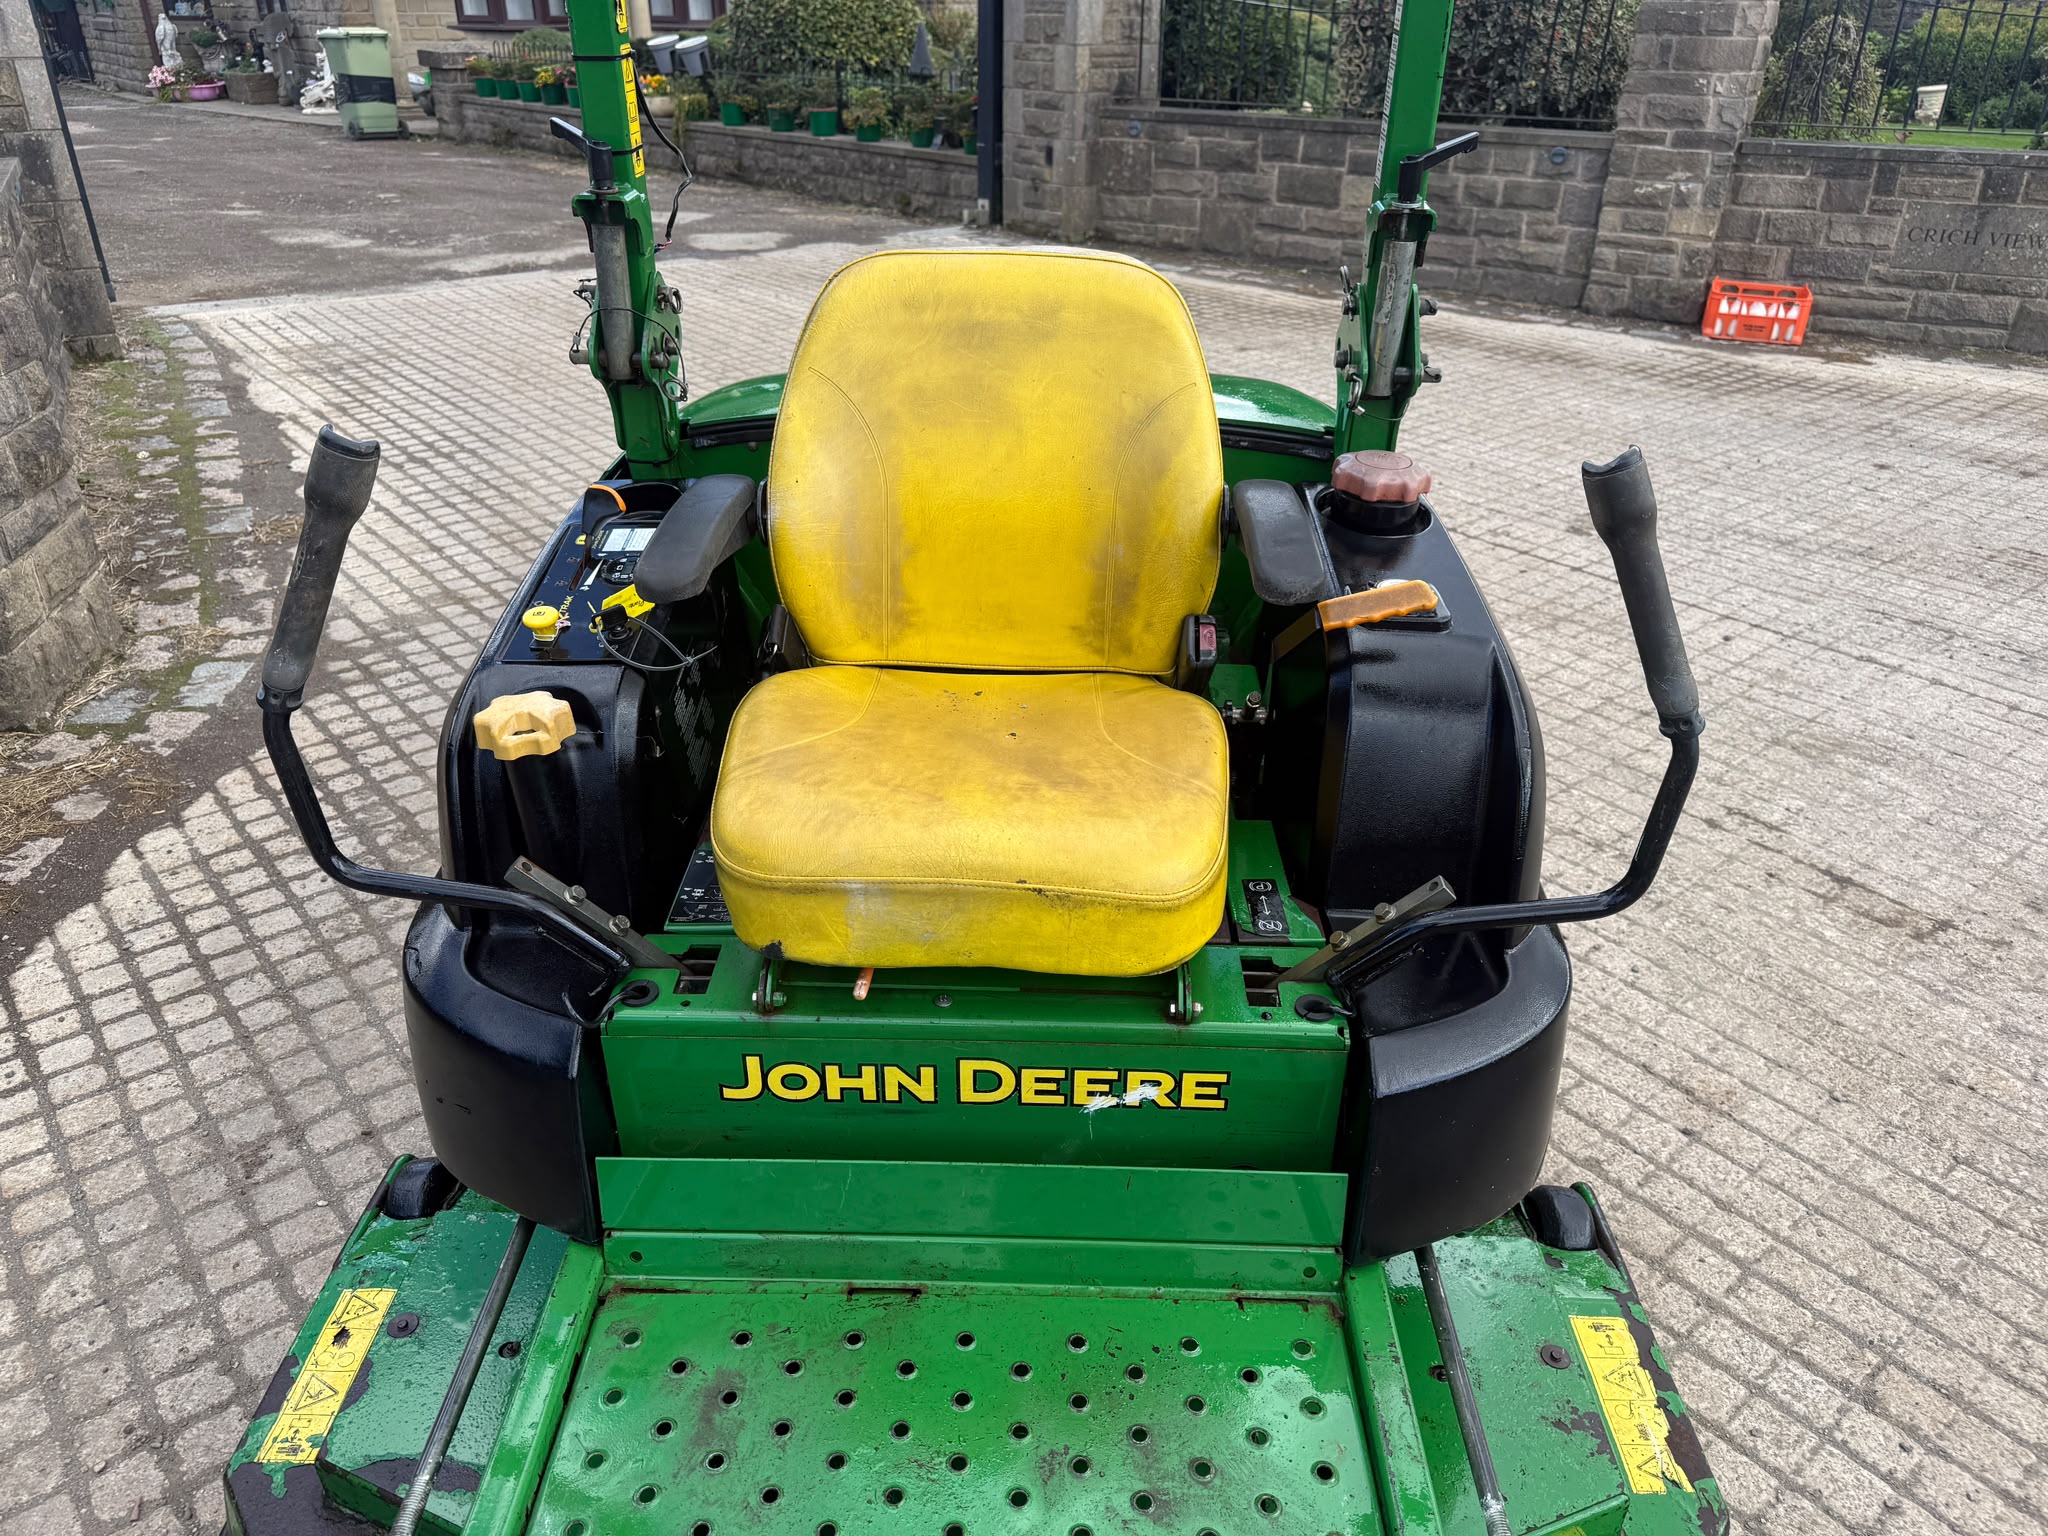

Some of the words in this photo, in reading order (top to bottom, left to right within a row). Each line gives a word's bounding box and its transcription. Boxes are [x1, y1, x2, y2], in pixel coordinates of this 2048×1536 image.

[1908, 227, 1979, 246] CRICH
[1990, 231, 2047, 250] VIEW
[719, 1053, 937, 1103] JOHN
[956, 1057, 1231, 1111] DEERE
